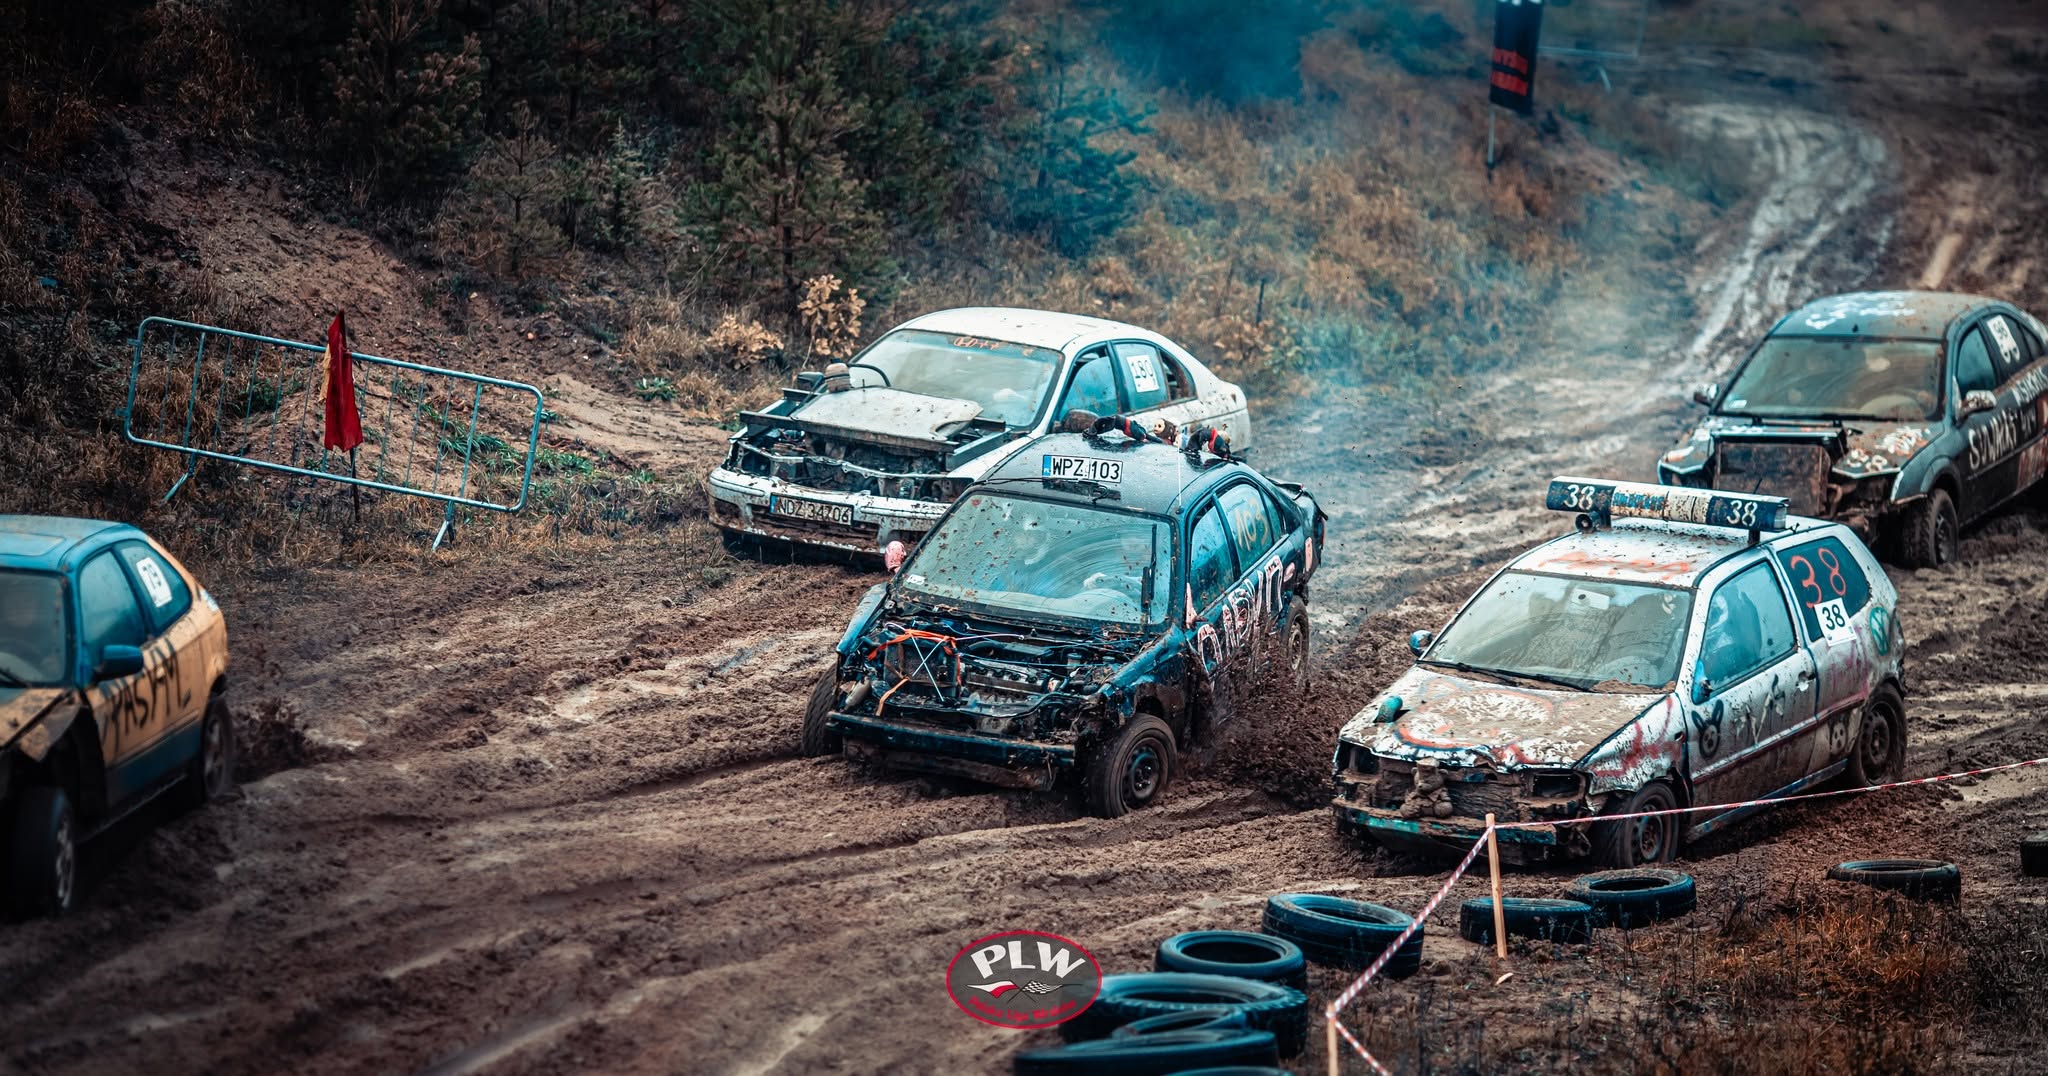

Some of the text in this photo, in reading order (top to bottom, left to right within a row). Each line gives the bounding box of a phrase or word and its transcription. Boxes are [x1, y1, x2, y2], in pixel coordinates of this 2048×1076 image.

[1131, 359, 1154, 380] 180
[1052, 458, 1120, 480] WPZ 103
[1563, 484, 1596, 511] 38
[1234, 497, 1269, 551] 103
[1727, 500, 1759, 527] 38
[1790, 548, 1847, 609] 38
[1822, 603, 1846, 631] 38
